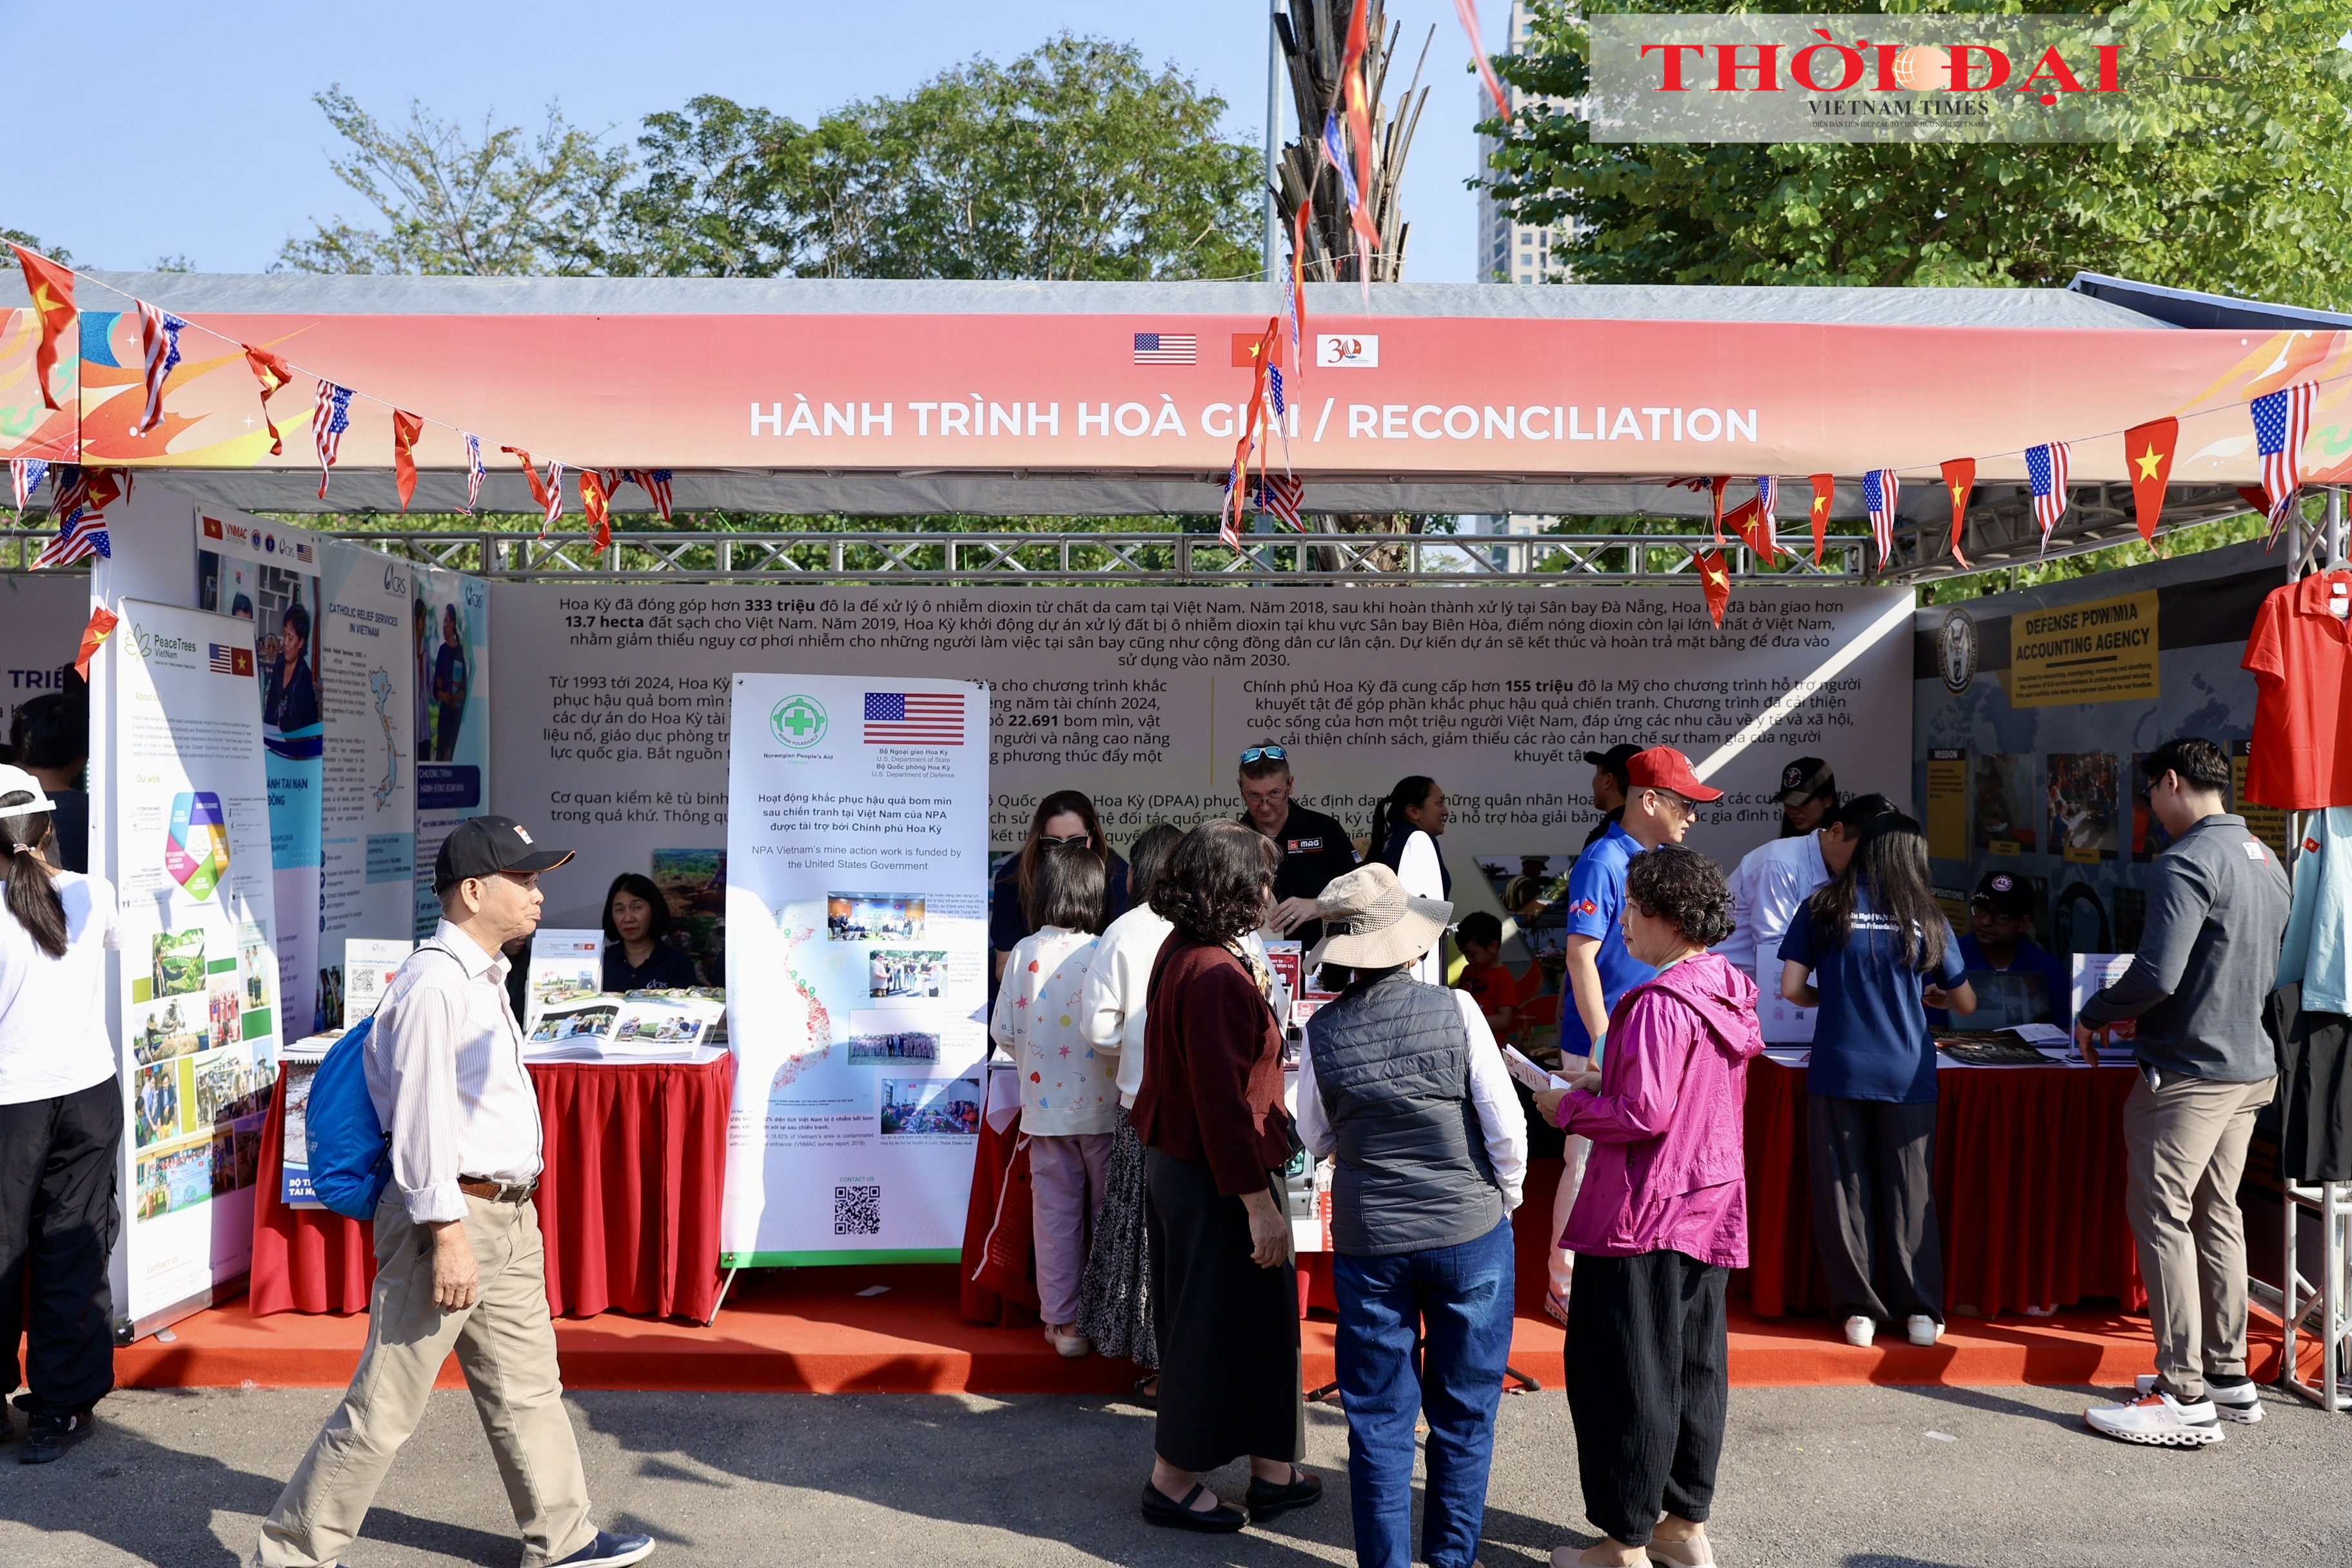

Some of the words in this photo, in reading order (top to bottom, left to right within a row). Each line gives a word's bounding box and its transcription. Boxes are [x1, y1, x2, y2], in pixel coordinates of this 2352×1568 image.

[751, 393, 892, 436] HÀNH
[908, 393, 1058, 435] TRÌNH
[1078, 394, 1187, 436] HOÀ
[1312, 397, 1335, 442] /
[1349, 405, 1756, 442] RECONCILIATION
[225, 523, 247, 539] VNMAC
[393, 576, 406, 593] CRS
[560, 598, 588, 609] Hoa
[594, 598, 611, 613] Kỳ
[615, 598, 632, 610] đã
[638, 598, 674, 614] đóng
[679, 598, 706, 614] góp
[712, 599, 740, 611] hơn
[745, 600, 772, 611] 333
[777, 599, 814, 614] triệu
[820, 600, 838, 611] đô
[843, 600, 855, 611] la
[329, 603, 356, 618] CATHOLIC
[357, 609, 374, 621] RELIEF
[375, 611, 398, 627] SERVICES
[2026, 612, 2077, 636] DEFENSE
[2082, 603, 2138, 627] POW/MIA
[349, 623, 355, 633] IN
[356, 624, 379, 637] VIETNAM
[155, 634, 196, 652] PeaceTrees
[2016, 636, 2092, 661] ACCOUNTING
[2095, 627, 2150, 651] AGENCY
[155, 648, 177, 659] VietNam
[1119, 652, 1137, 665] sử
[1141, 654, 1178, 669] dụng
[1182, 654, 1208, 665] vào
[1213, 653, 1245, 665] năm
[1251, 654, 1289, 665] 2030.
[1505, 680, 1531, 692] 155
[1536, 680, 1573, 694] triệu
[1578, 680, 1596, 691] đô
[1602, 680, 1612, 691] la
[135, 692, 152, 701] About
[778, 732, 791, 744] NORSK
[792, 735, 818, 745] FOLKEHJELP
[1934, 750, 1957, 758] MISSION
[877, 761, 886, 770] Bộ
[928, 761, 940, 770] Hoa
[942, 762, 950, 771] Kỳ
[282, 779, 291, 789] TAI
[293, 779, 308, 791] NẠN
[759, 794, 781, 803] Hoạt
[784, 793, 808, 803] động
[812, 792, 835, 802] khắc
[839, 795, 863, 805] phục
[867, 796, 884, 805] hậu
[888, 796, 905, 806] quả
[909, 796, 930, 805] bom
[783, 806, 809, 816] chiến
[842, 809, 854, 818] tại
[857, 809, 876, 819] Việt
[926, 810, 946, 819] NPA
[770, 823, 796, 832] được
[814, 822, 829, 831] trợ
[832, 822, 848, 830] bởi
[852, 823, 881, 832] Chính
[885, 824, 903, 834] phủ
[929, 825, 941, 834] Kỳ
[752, 846, 774, 854] NPA
[776, 845, 821, 854] Vietnam's
[824, 845, 846, 854] mine
[905, 847, 912, 856] is
[916, 847, 947, 856] funded
[950, 848, 961, 858] by
[788, 860, 801, 868] the
[805, 859, 834, 868] United
[838, 859, 867, 868] States
[870, 861, 927, 870] Government
[1930, 887, 1964, 900] OPERATIONS
[1867, 923, 1899, 932] Friendship
[289, 1178, 301, 1188] BỘ
